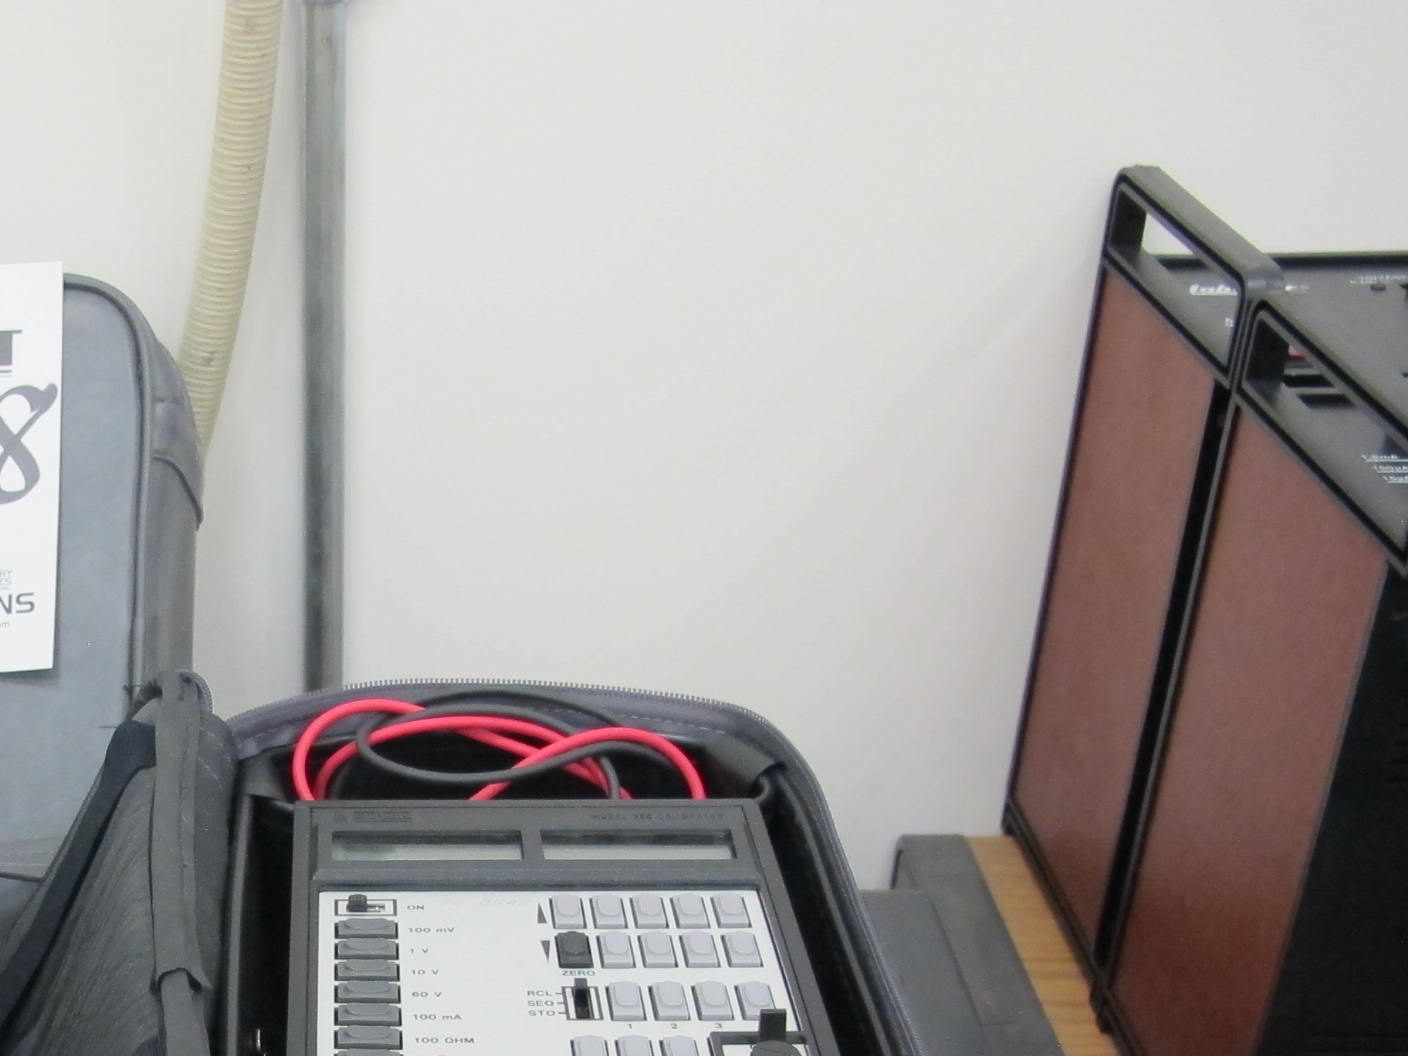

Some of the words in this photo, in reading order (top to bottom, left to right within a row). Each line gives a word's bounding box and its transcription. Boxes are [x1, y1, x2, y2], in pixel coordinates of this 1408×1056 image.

[408, 926, 431, 934] 100
[435, 926, 455, 934] mV
[410, 968, 427, 976] 10
[430, 968, 440, 976] V
[413, 1013, 437, 1021] 100
[440, 1013, 462, 1021] mA
[414, 1036, 440, 1044] 100
[444, 1036, 475, 1044] OHM
